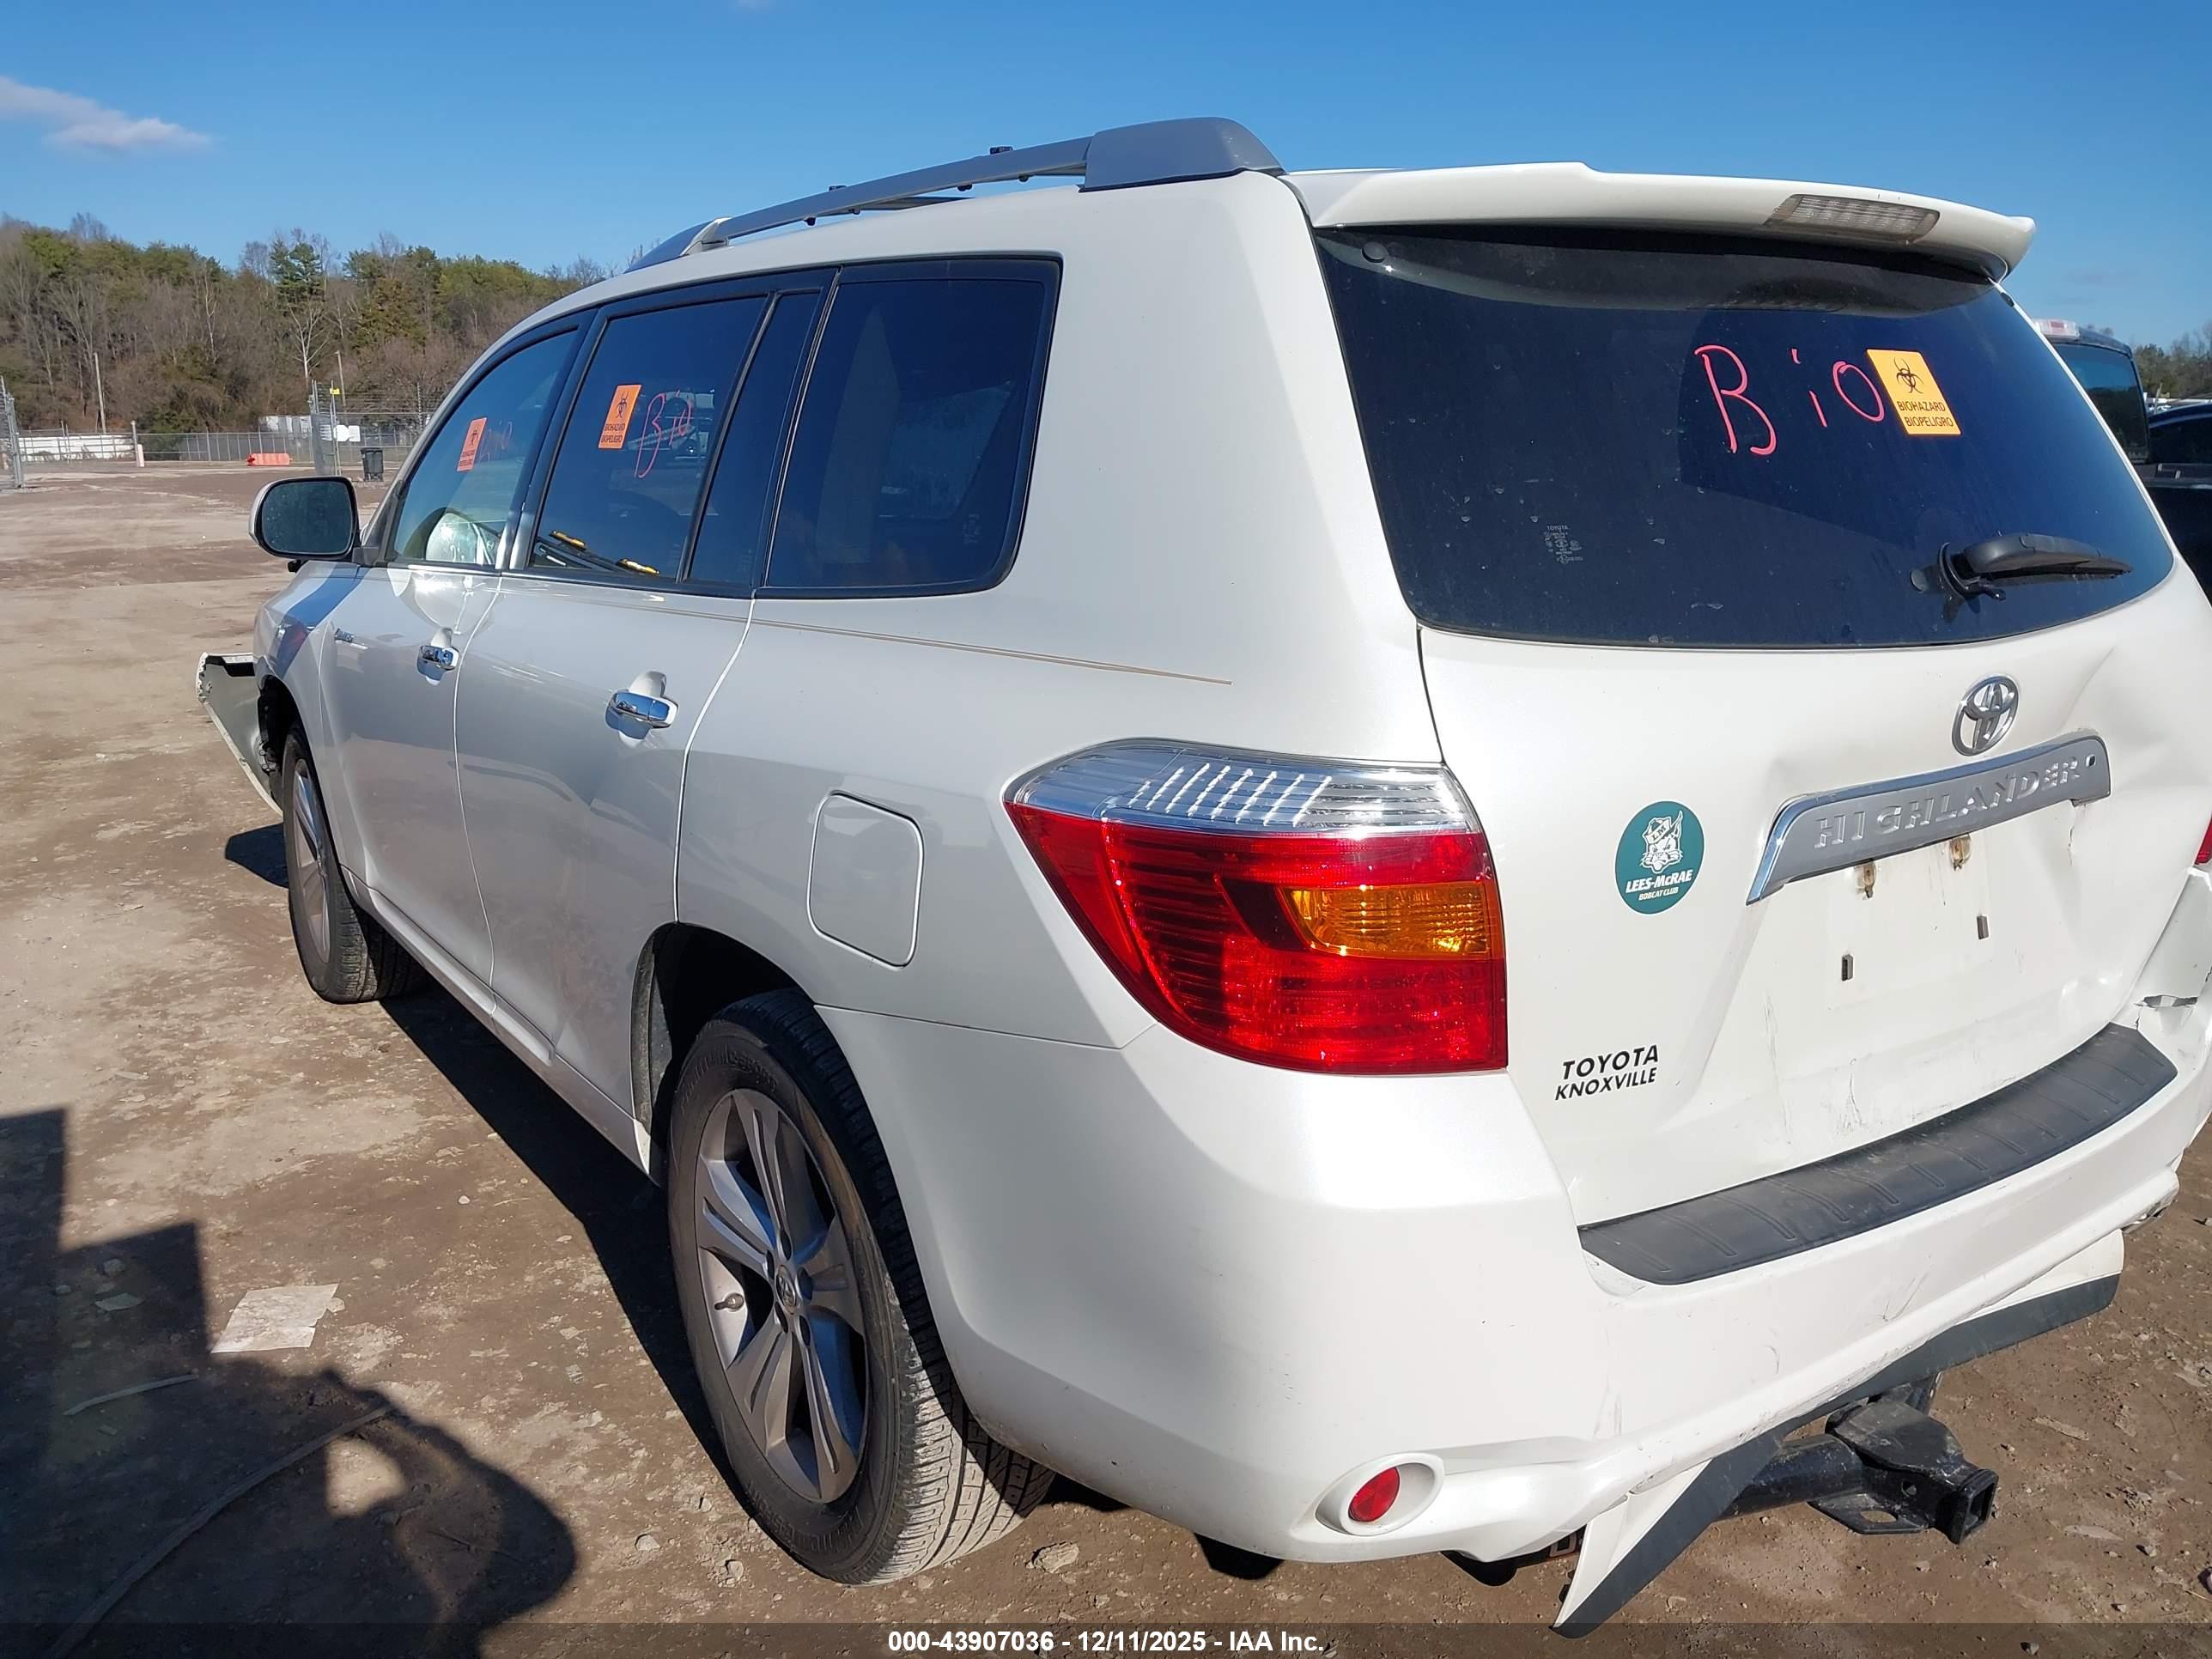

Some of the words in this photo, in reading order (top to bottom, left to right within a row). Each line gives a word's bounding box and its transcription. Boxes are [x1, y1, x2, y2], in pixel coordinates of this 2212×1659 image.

[1896, 400, 1947, 412] BIOHAZARD
[1904, 416, 1954, 427] BIOPELIGRO
[1814, 756, 2081, 849] HIGHLANDER
[1626, 869, 1693, 894] LEES-McRAE
[1638, 890, 1664, 901] BOBCAT
[1663, 887, 1680, 897] CLUB
[1562, 1044, 1659, 1079] TOYOTA
[1554, 1067, 1657, 1101] KNOXVILLE
